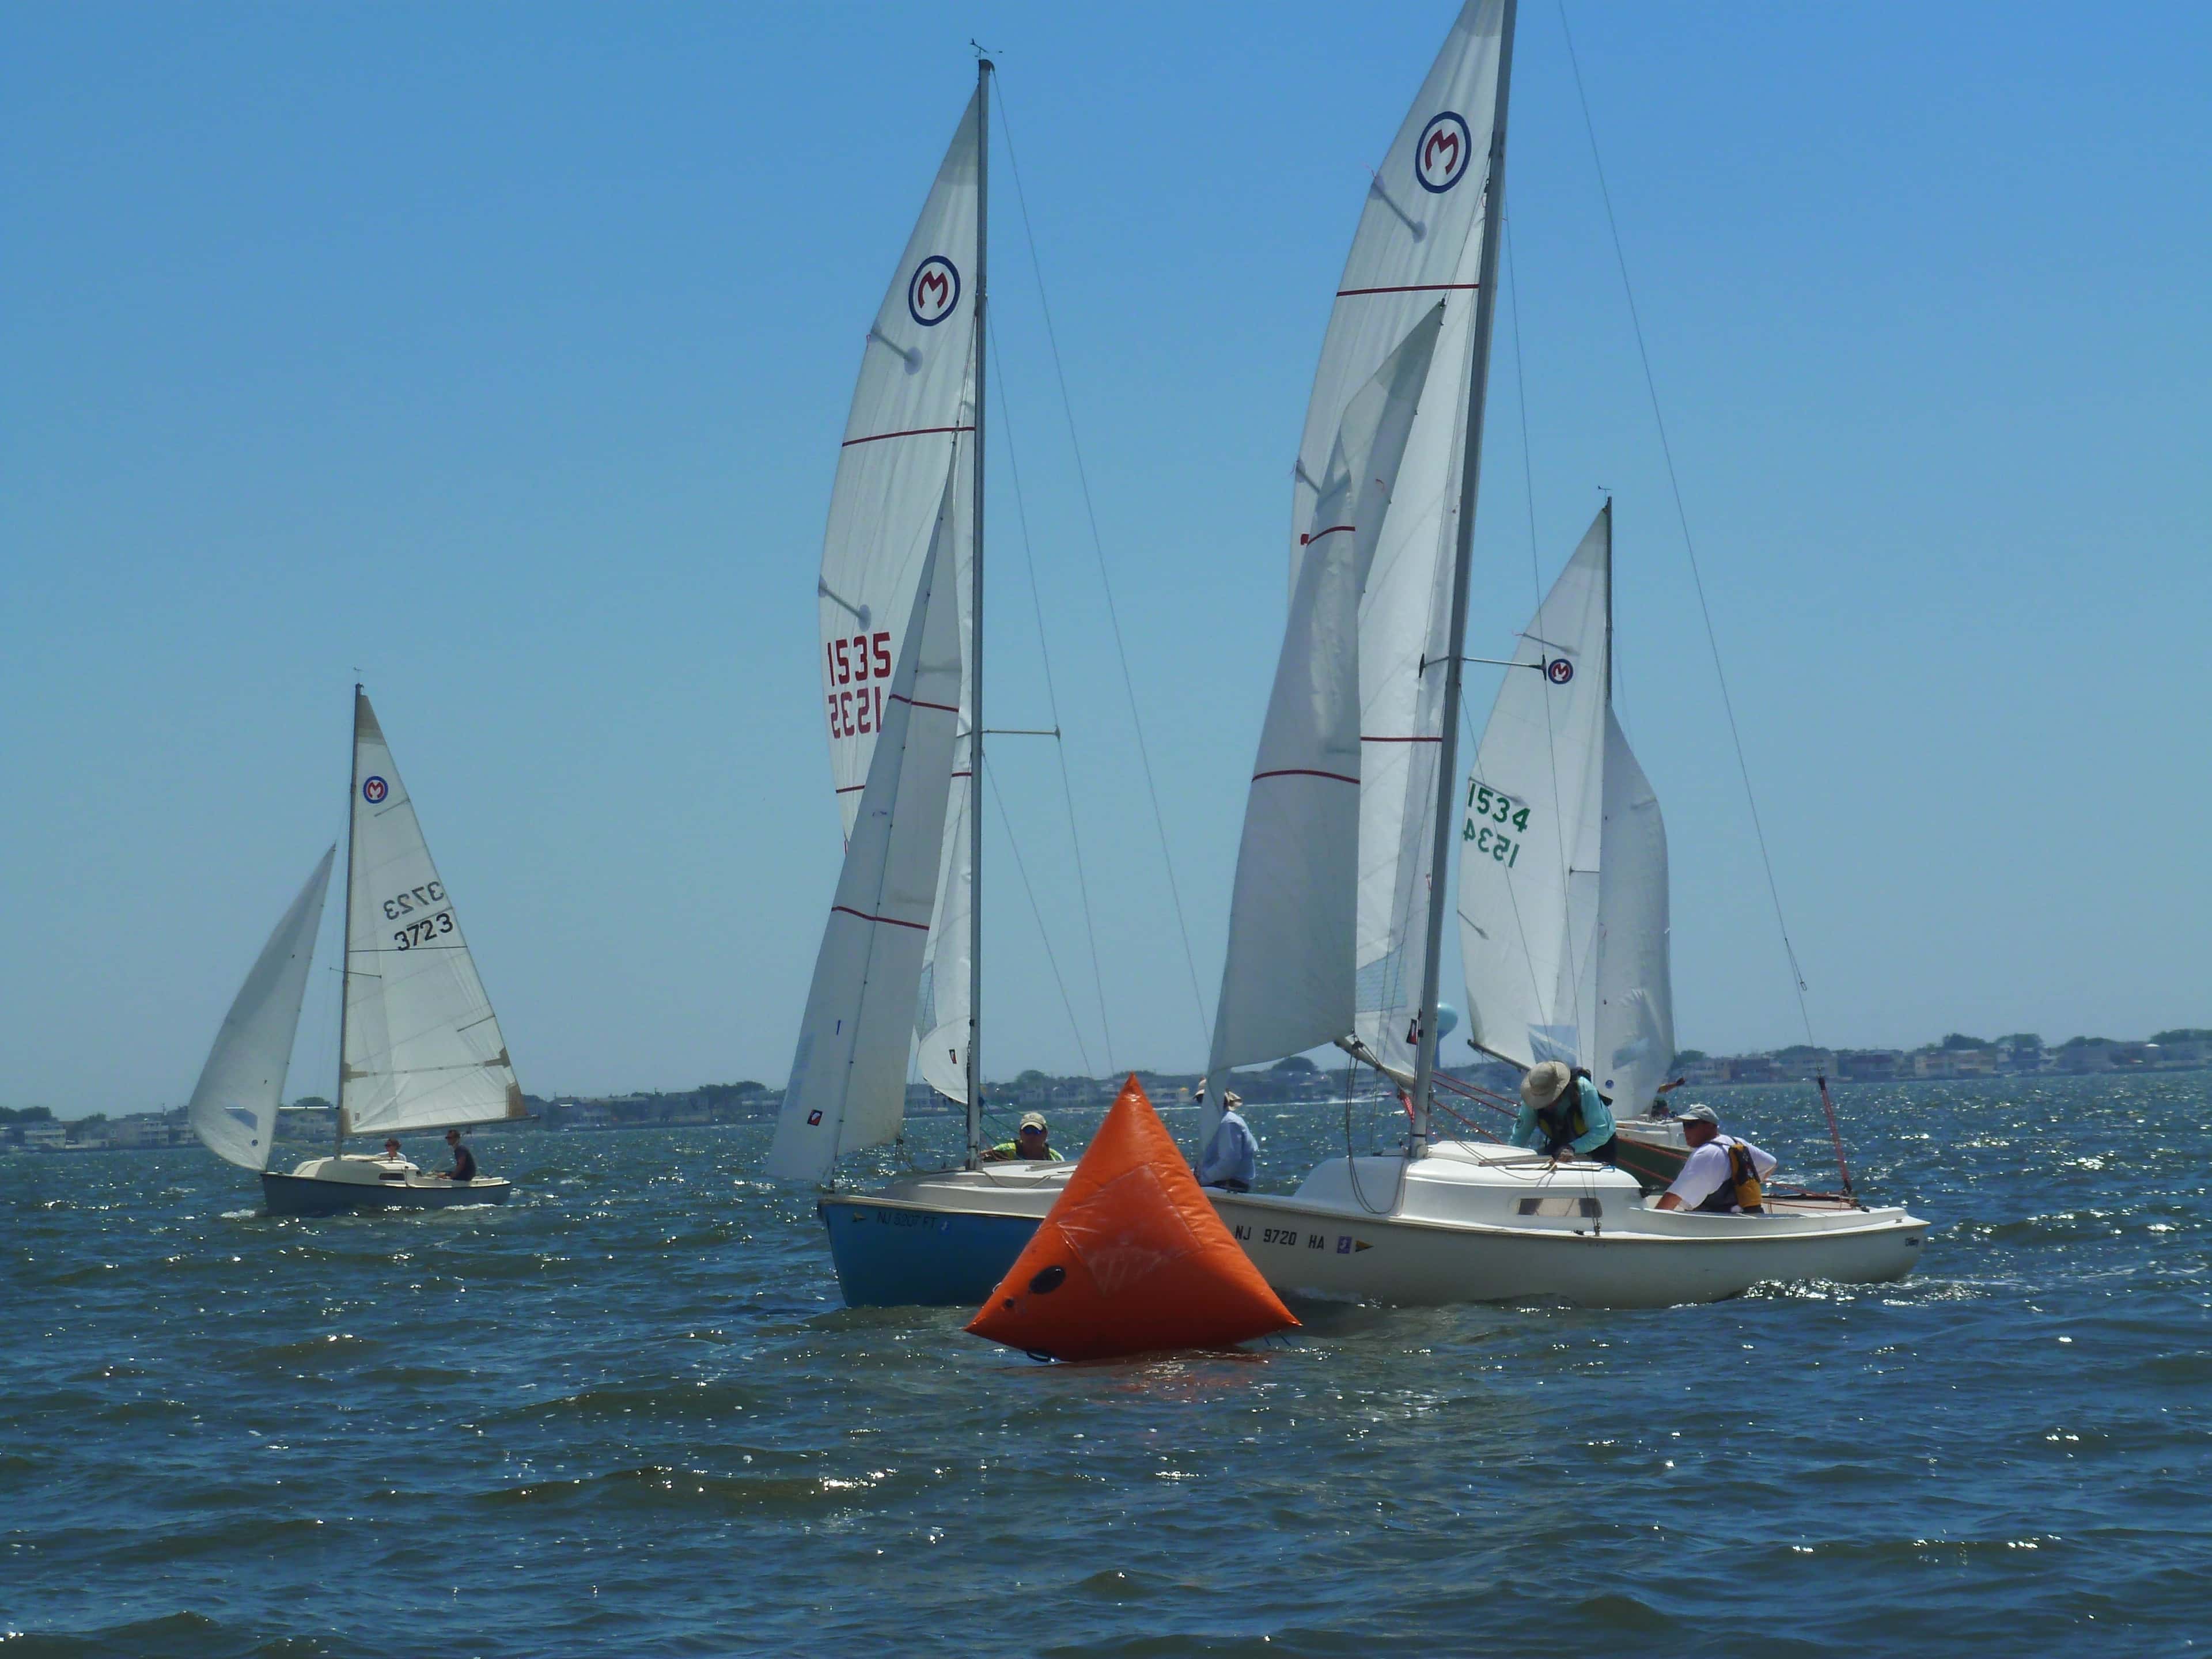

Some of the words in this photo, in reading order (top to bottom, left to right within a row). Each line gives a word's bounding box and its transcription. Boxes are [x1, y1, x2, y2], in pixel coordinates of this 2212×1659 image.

[827, 632, 891, 687] 1535
[1468, 783, 1531, 834] 1534
[394, 912, 453, 951] 3723
[1235, 1225, 1252, 1240] NJ
[1263, 1228, 1297, 1246] 9720
[1308, 1234, 1325, 1249] HA
